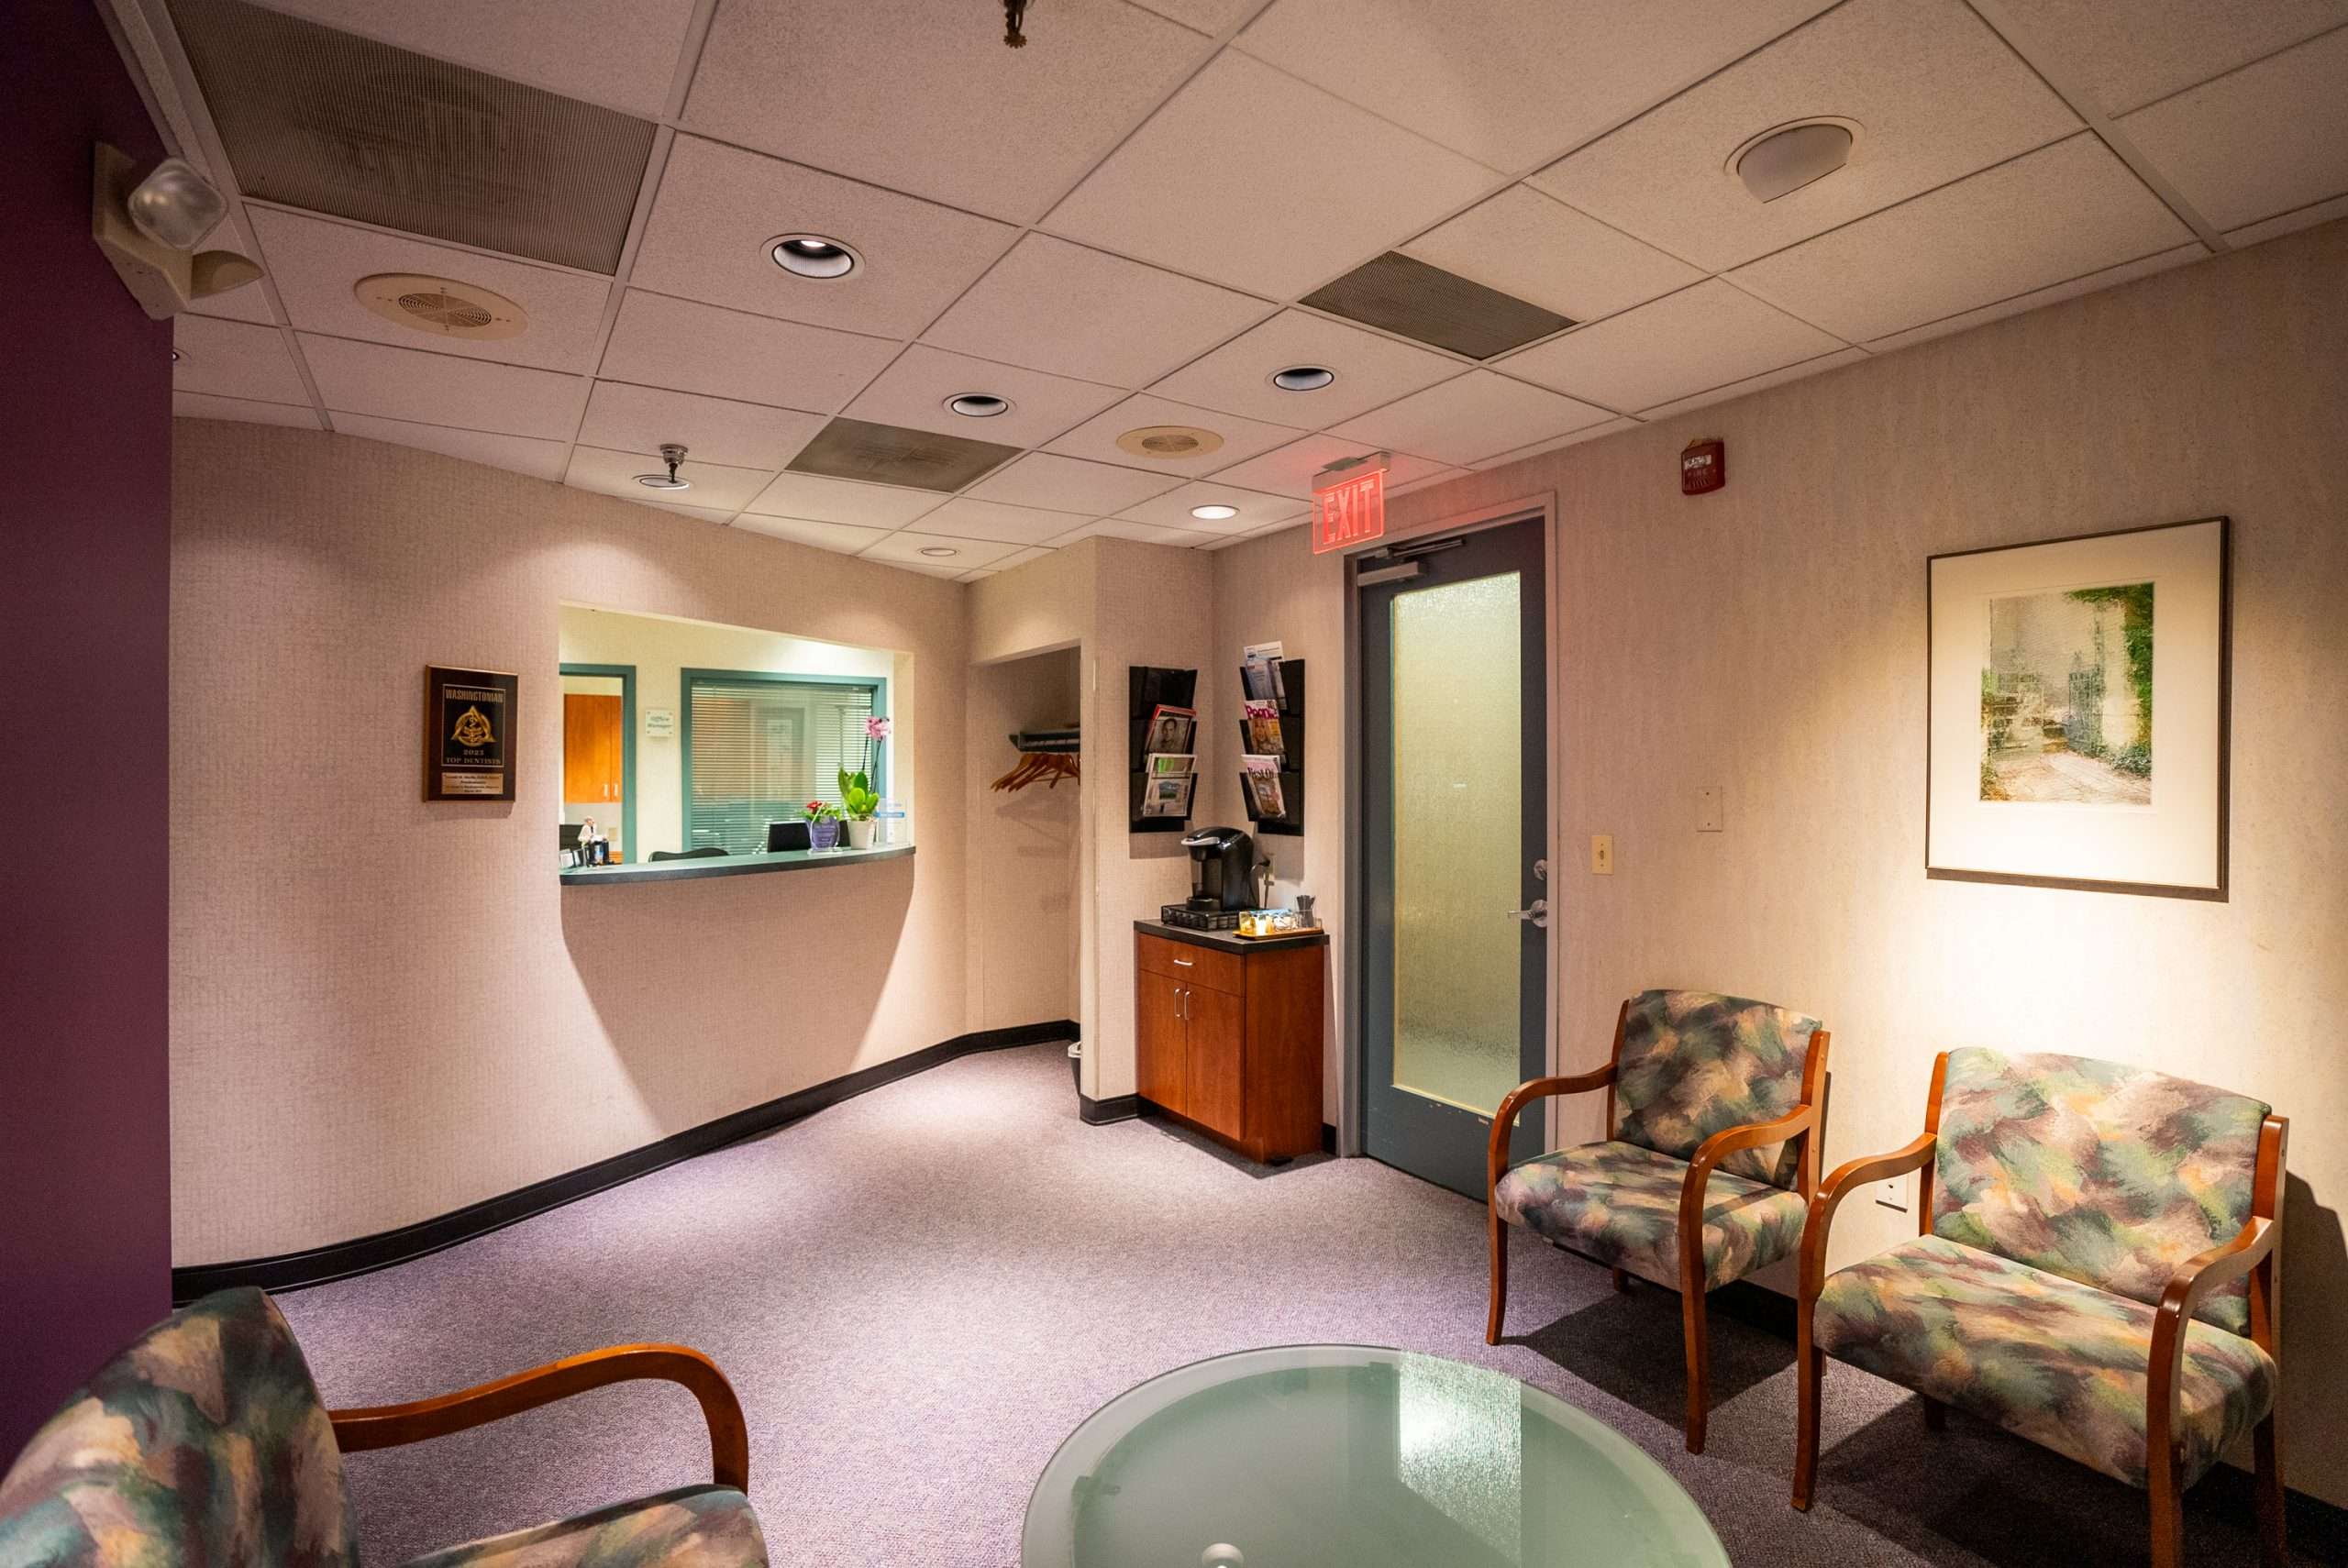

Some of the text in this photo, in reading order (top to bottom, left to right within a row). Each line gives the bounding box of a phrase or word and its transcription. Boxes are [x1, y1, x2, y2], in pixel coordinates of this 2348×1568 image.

[1323, 479, 1375, 545] EXIT
[445, 689, 504, 703] WASHINGTONIAN
[464, 756, 501, 765] DENTISTS
